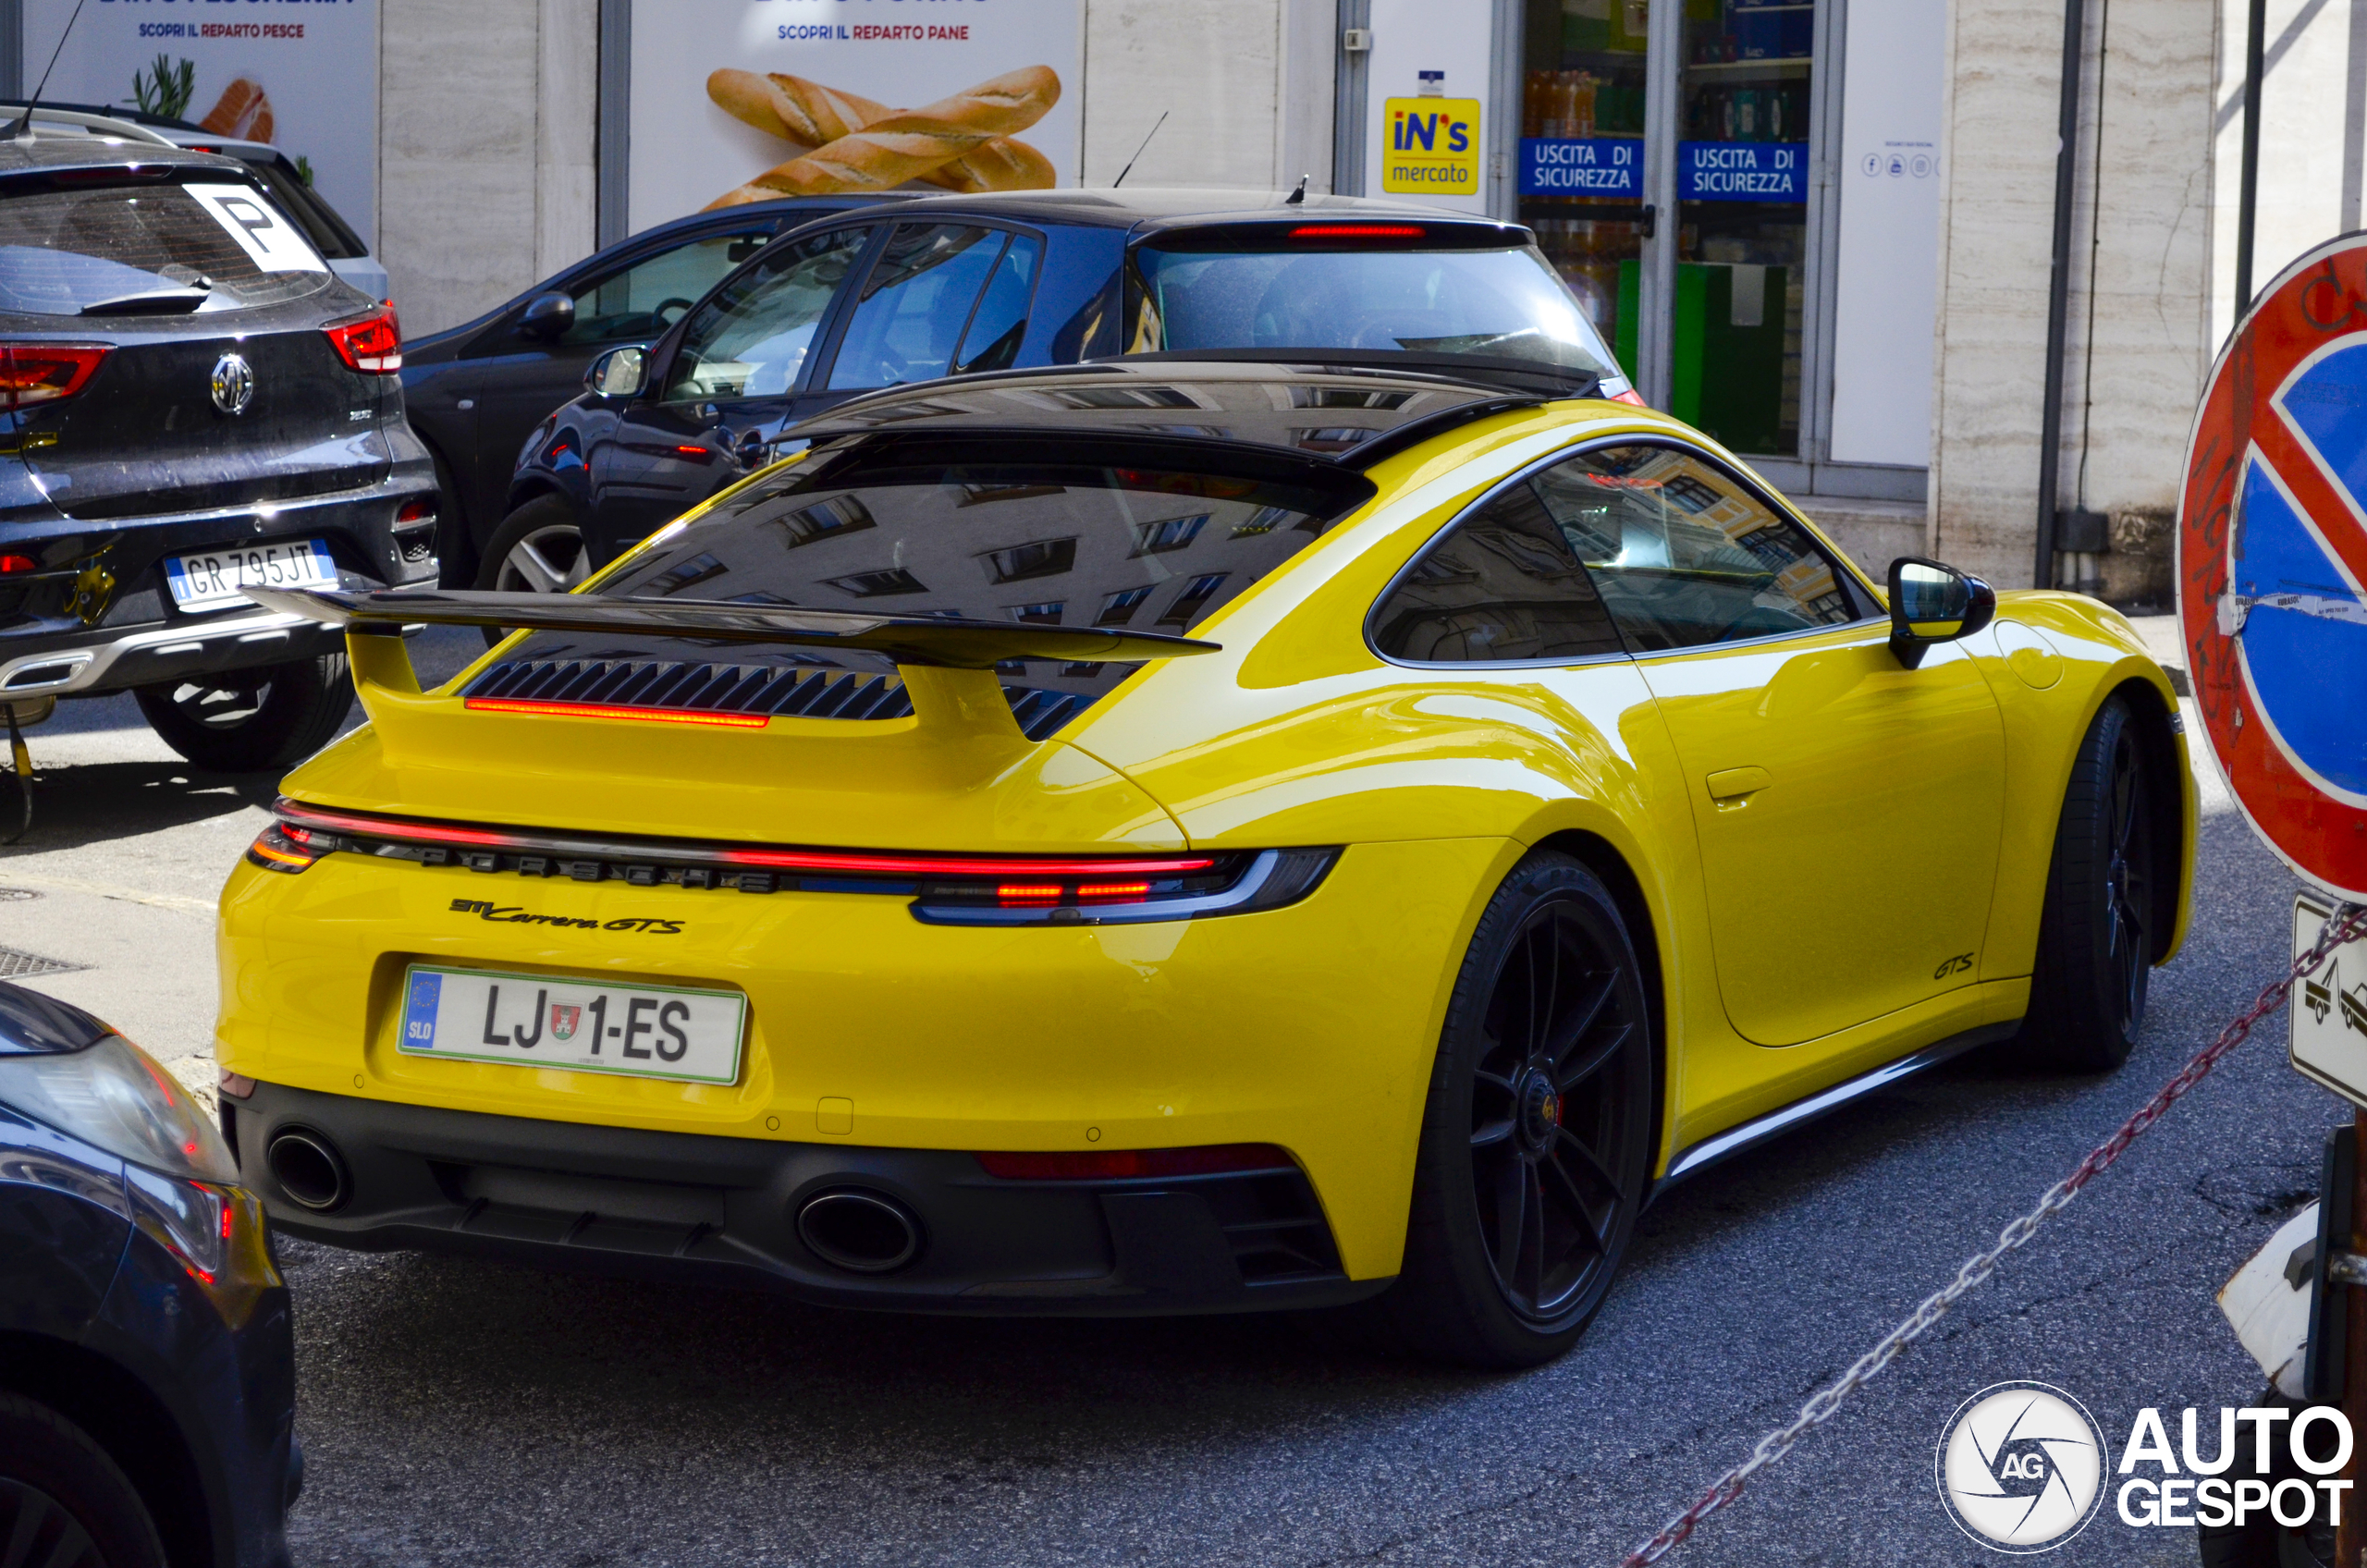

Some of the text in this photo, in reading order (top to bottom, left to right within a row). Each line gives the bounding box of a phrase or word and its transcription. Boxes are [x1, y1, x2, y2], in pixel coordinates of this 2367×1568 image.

[139, 23, 304, 39] SCOPRI IL REPARTO PESCE
[778, 25, 969, 40] SCOPRI IL REPARTO PANE
[1535, 144, 1632, 165] USCITA DI
[1694, 148, 1794, 169] USCITA DI
[1393, 164, 1468, 183] mercato
[1534, 167, 1631, 189] SICUREZZA
[1693, 172, 1794, 192] SICUREZZA
[188, 557, 227, 594] GR
[420, 847, 778, 895] PORSCHE
[481, 907, 599, 930] Carrera
[602, 917, 686, 935] GTS
[1934, 952, 1975, 980] GTS
[408, 1021, 432, 1041] SLO
